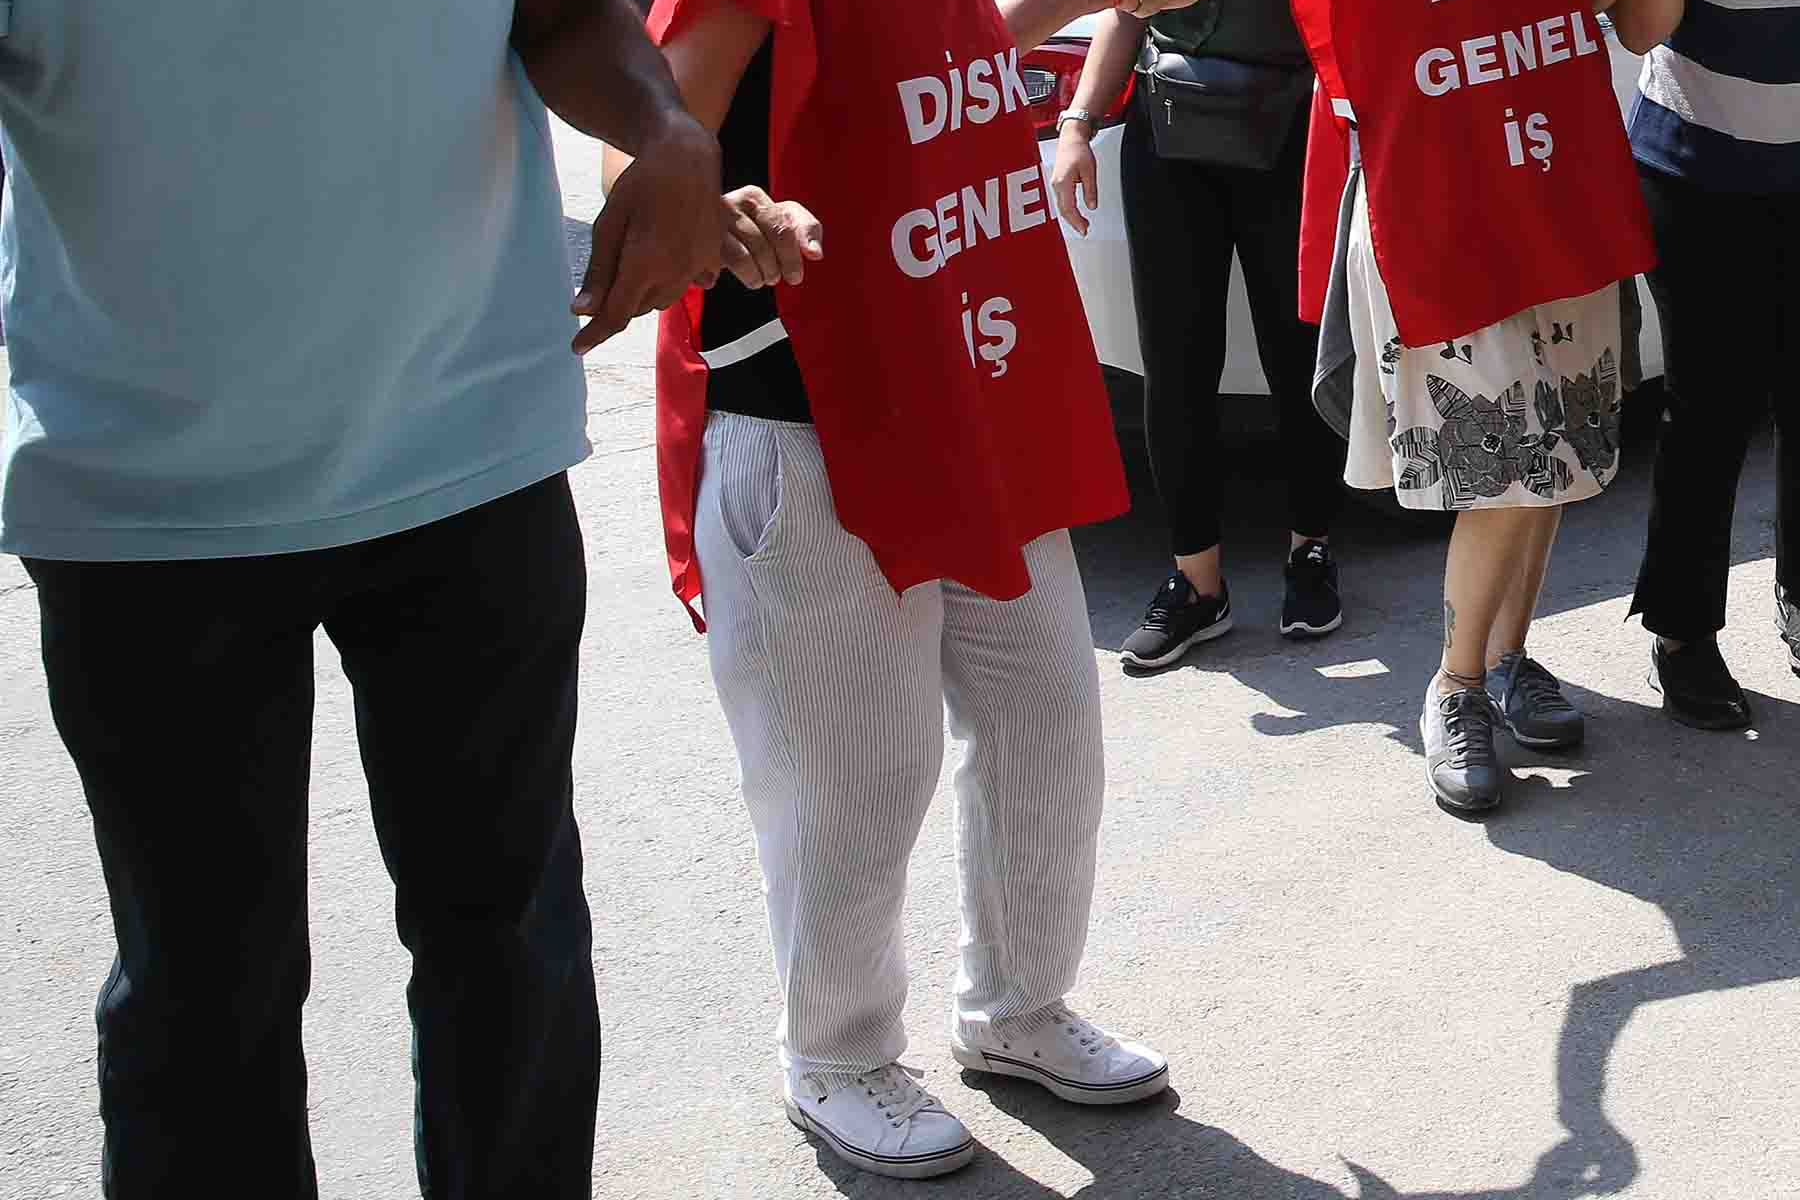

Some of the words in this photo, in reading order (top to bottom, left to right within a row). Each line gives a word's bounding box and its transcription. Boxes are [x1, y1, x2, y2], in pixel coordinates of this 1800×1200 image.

[897, 47, 1031, 145] DİSK
[1414, 11, 1599, 96] GENEL
[1503, 107, 1554, 172] İŞ
[890, 164, 1057, 278] GENE
[961, 291, 1018, 378] İŞ
